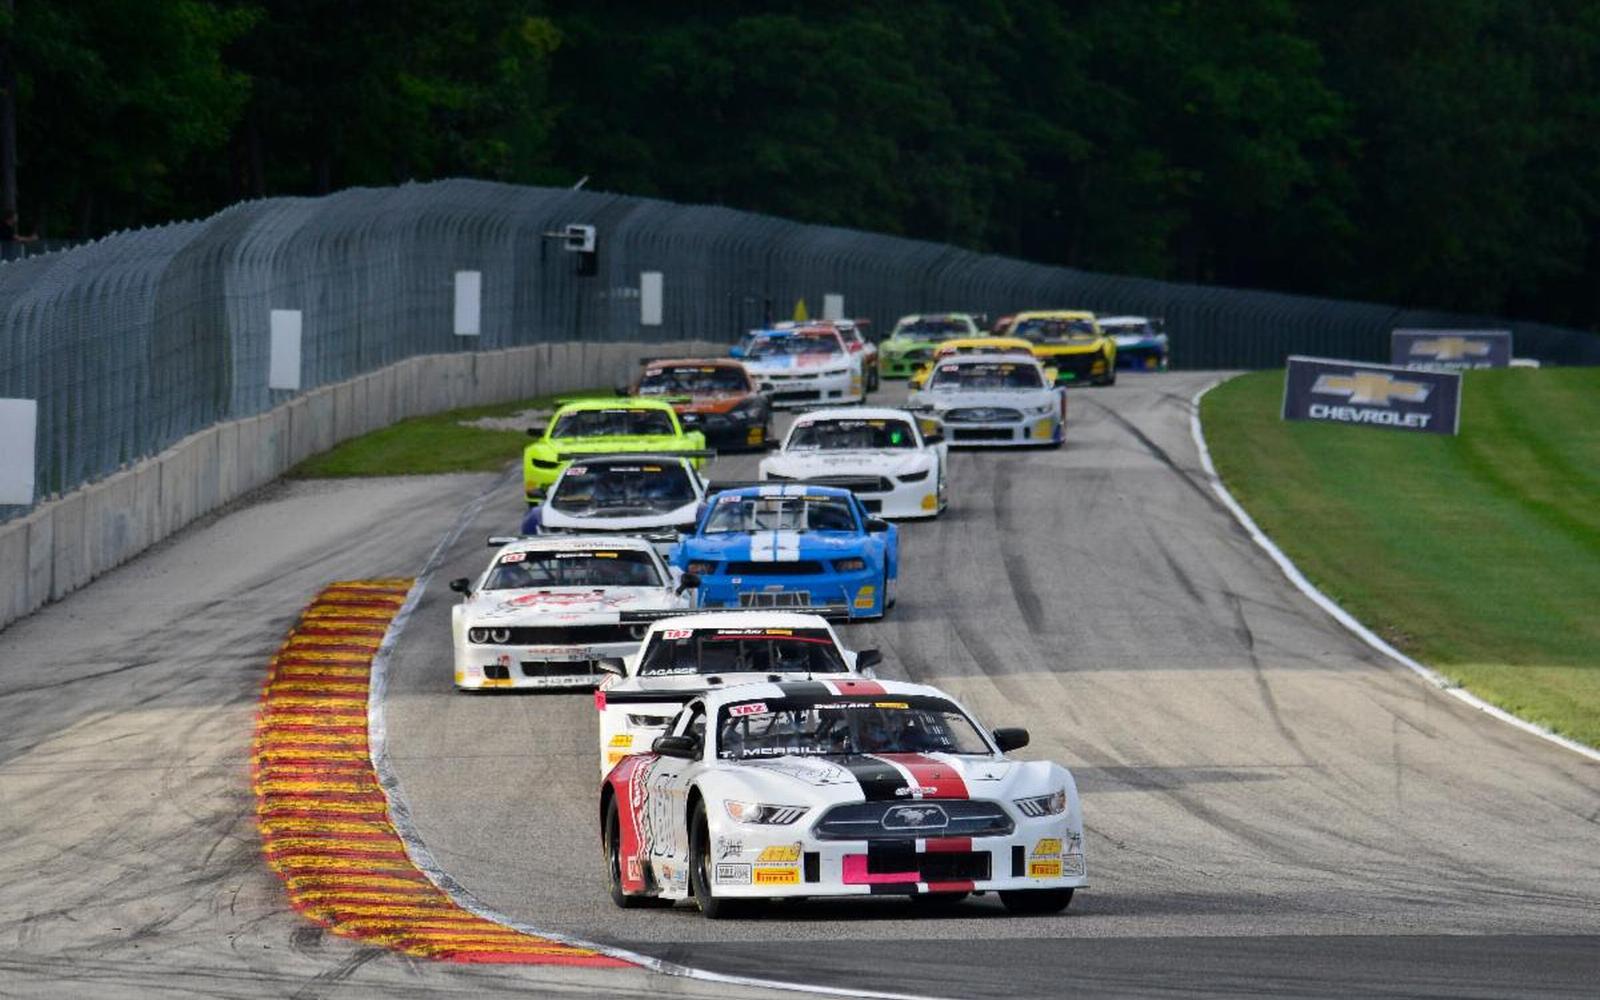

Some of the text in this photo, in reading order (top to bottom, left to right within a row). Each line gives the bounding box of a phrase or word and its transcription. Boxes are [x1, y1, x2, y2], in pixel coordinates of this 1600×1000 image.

[1309, 404, 1431, 428] CHEVROLET
[641, 667, 697, 677] LAGASSE
[733, 704, 767, 715] TA2
[743, 746, 828, 757] MERRILL
[1031, 864, 1060, 875] PIRELLI
[756, 871, 795, 882] PIRELLI
